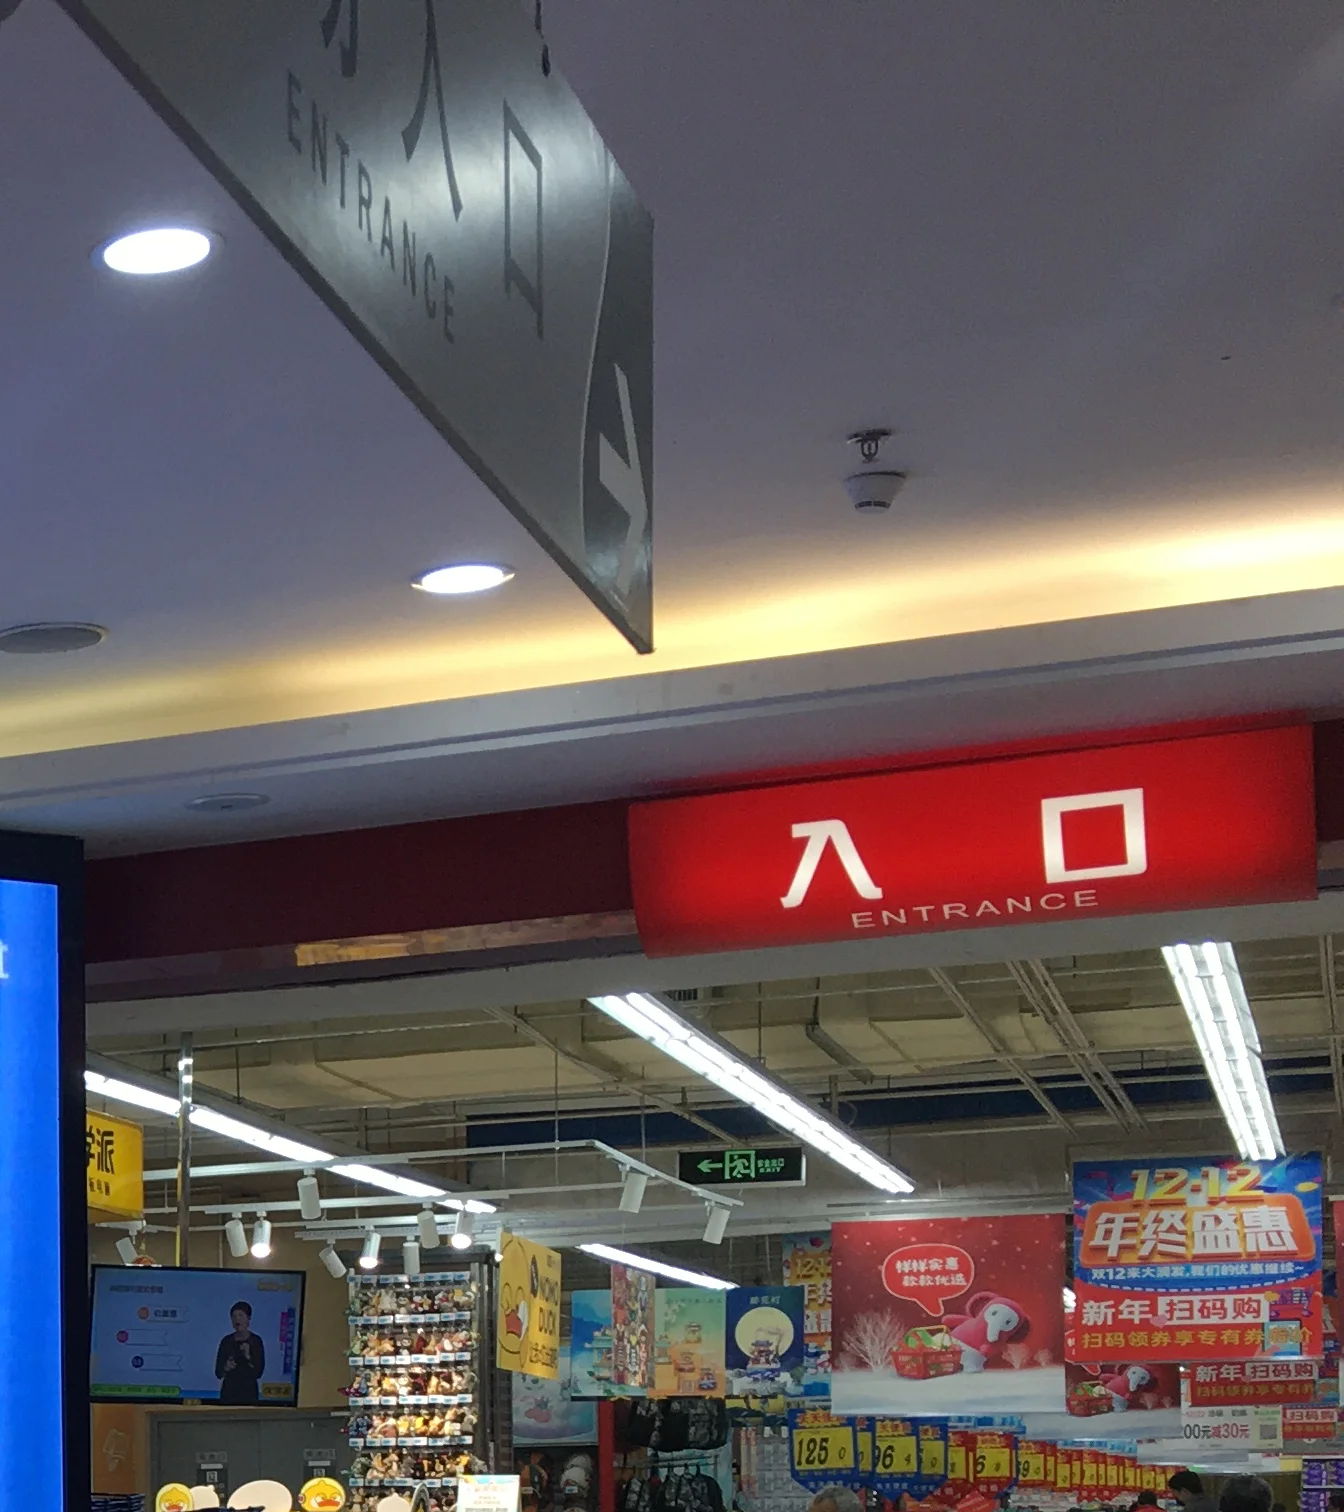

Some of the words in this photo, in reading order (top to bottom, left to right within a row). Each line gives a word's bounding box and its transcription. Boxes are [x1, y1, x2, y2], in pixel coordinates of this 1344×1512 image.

[320, 0, 543, 340] 入口
[288, 68, 455, 344] ENTRANCE
[780, 788, 1147, 908] 入口
[851, 888, 1099, 929] ENTRANCE
[1089, 1205, 1298, 1261] 年终盛惠
[896, 1257, 959, 1273] 样样实惠
[903, 1274, 967, 1287] 款款优选
[797, 1437, 829, 1467] 125
